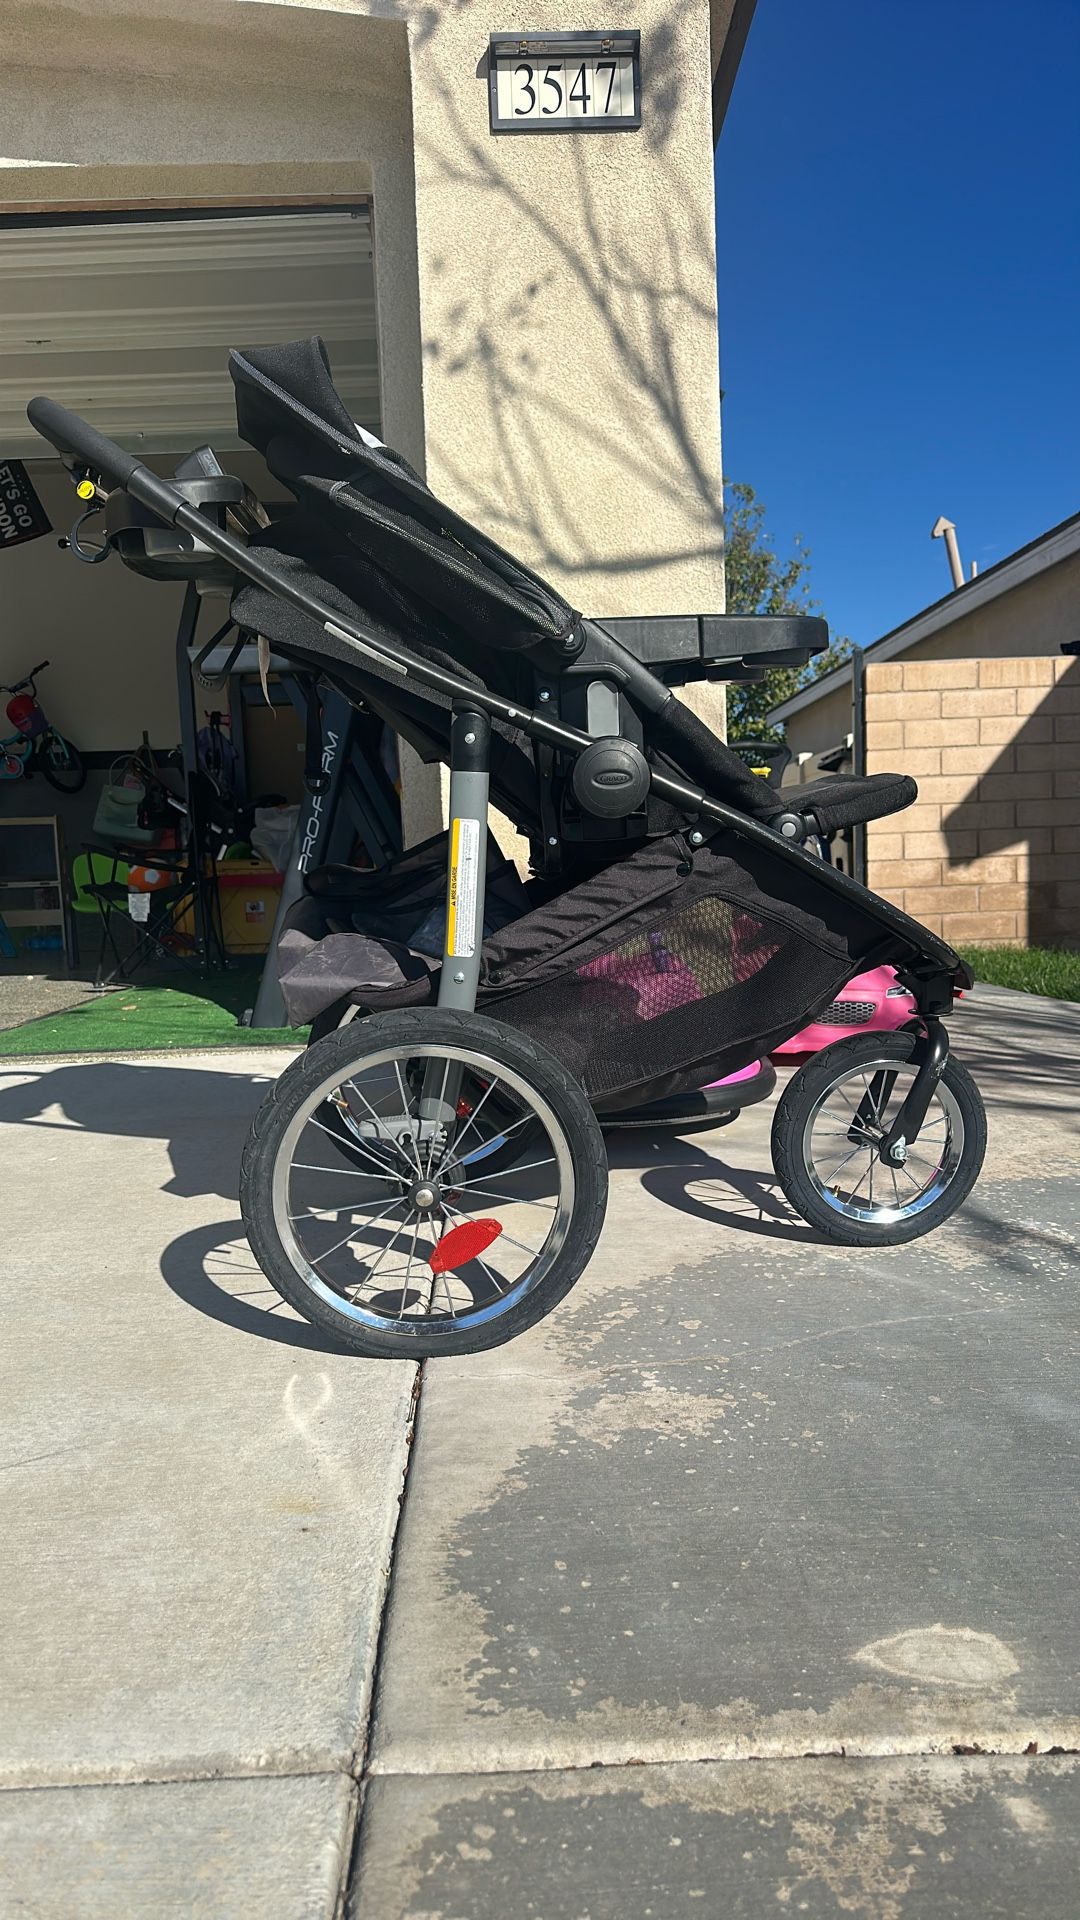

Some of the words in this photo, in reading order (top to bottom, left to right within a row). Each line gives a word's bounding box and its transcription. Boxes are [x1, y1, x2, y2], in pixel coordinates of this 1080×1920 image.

[514, 62, 617, 115] 3547
[0, 462, 20, 500] ET'S
[13, 504, 33, 527] GO
[298, 731, 339, 874] PRO-FRM
